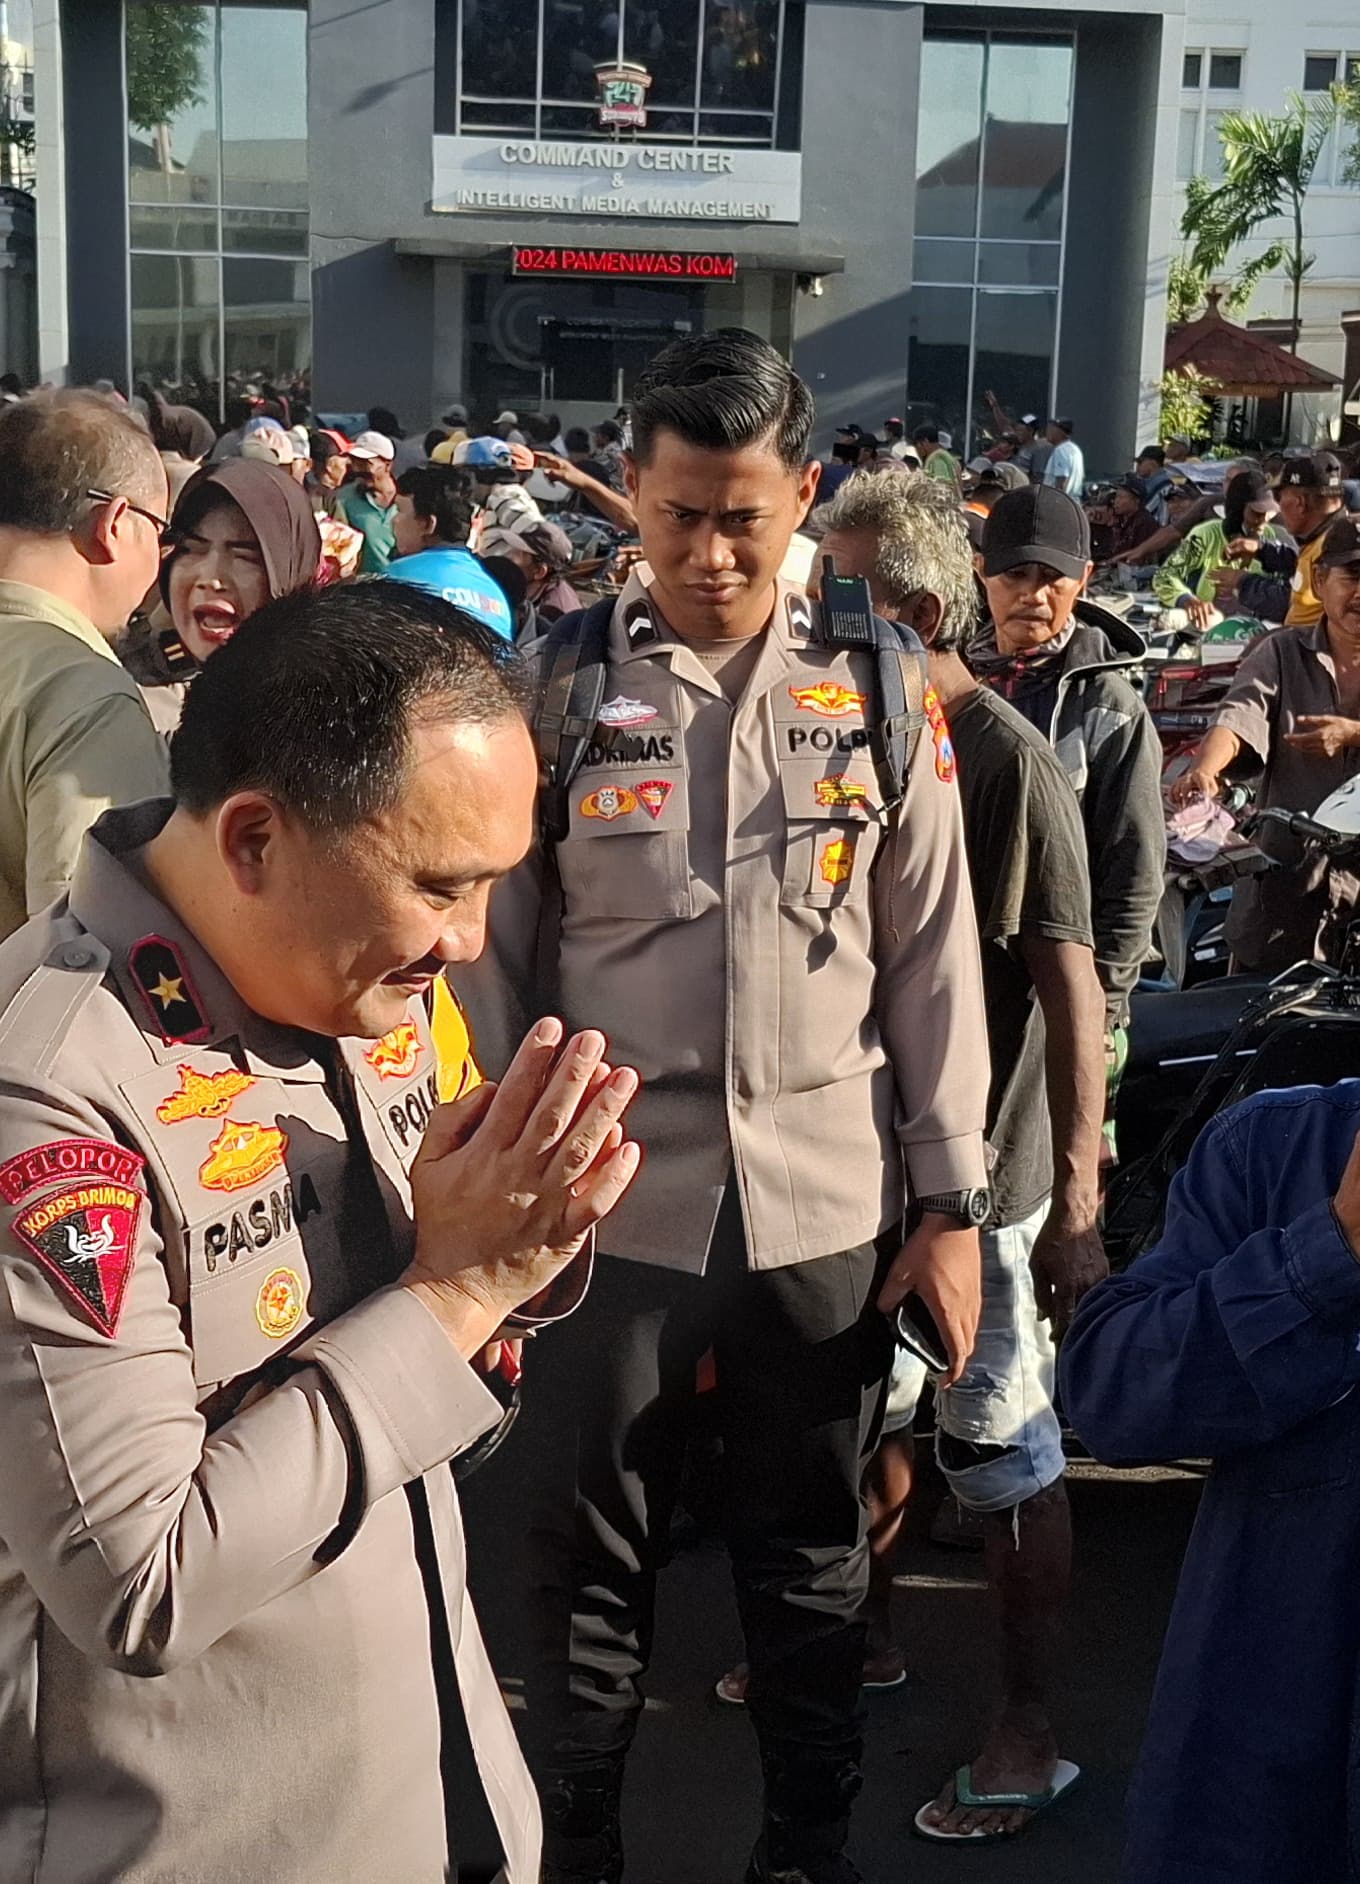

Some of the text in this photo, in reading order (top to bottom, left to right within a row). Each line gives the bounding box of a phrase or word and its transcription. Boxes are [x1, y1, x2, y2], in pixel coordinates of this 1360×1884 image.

[500, 143, 735, 174] COMMAND CENTER
[610, 172, 625, 188] &
[455, 189, 773, 219] INTELLIGENT MEDIA MANAGEMENT
[561, 249, 682, 274] PAMENWAS
[686, 255, 733, 275] KOM
[787, 725, 874, 753] POLR
[7, 1147, 134, 1191] PELOPOR
[22, 1185, 135, 1238] KORPS BRIMOB
